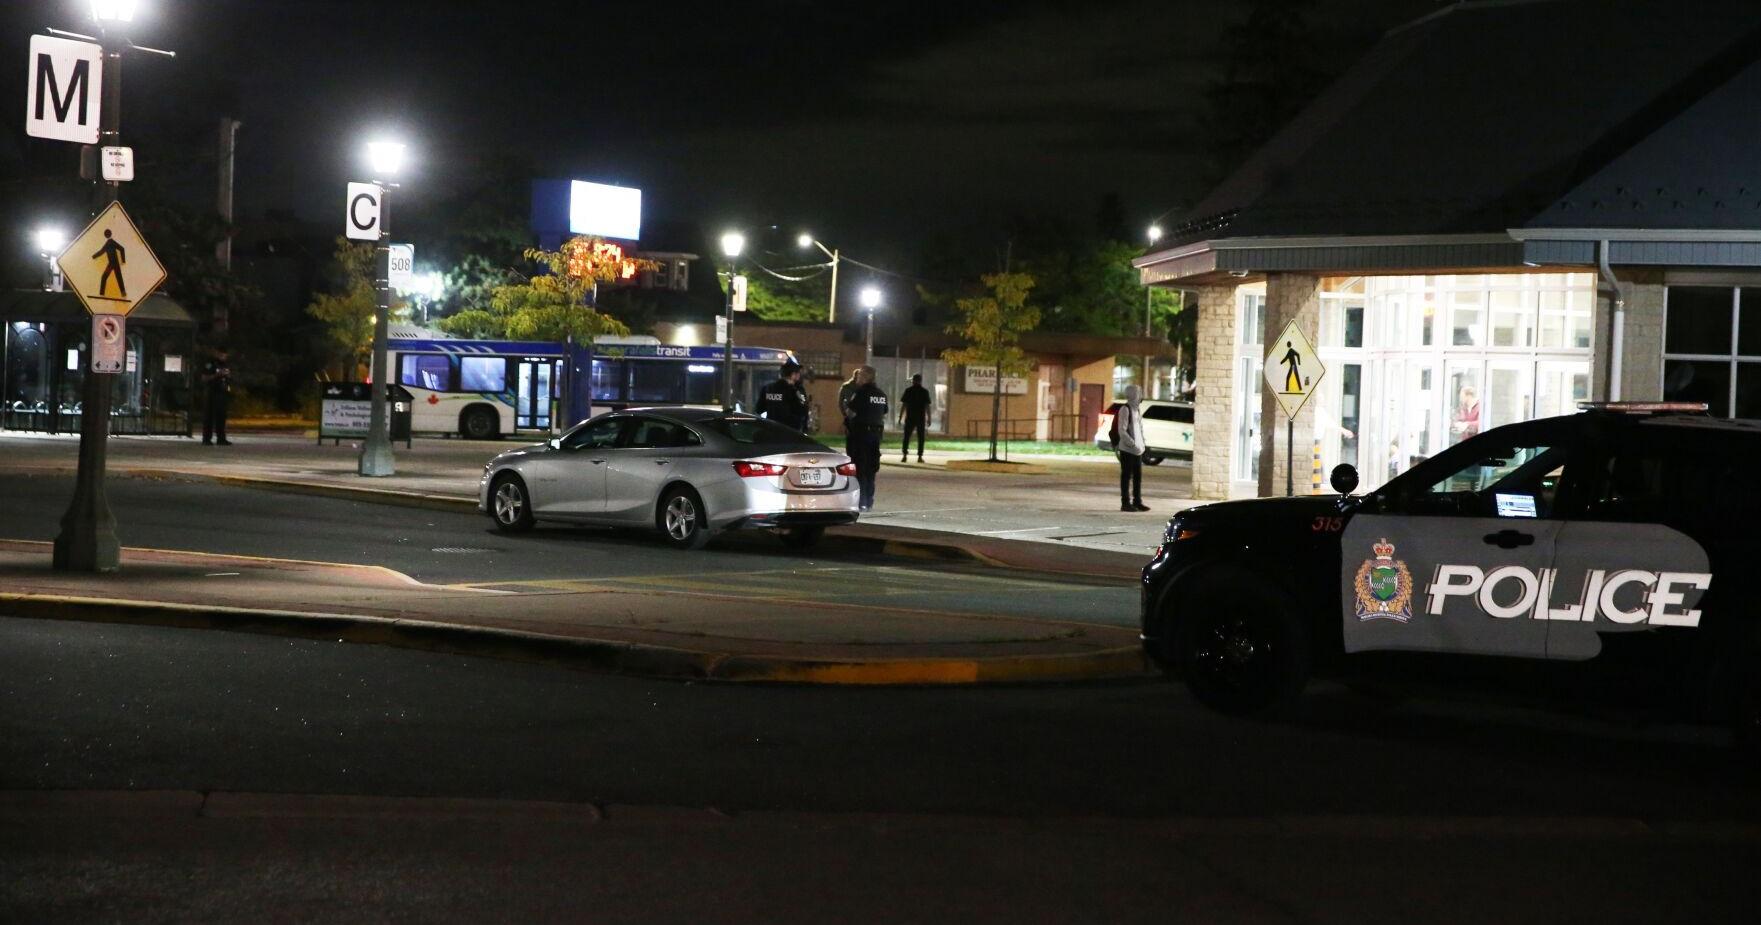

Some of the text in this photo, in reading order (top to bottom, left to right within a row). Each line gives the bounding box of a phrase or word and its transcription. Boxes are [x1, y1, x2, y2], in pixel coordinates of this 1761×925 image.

[35, 53, 90, 126] M
[351, 193, 377, 231] C
[391, 258, 411, 271] 508
[656, 345, 691, 357] transit
[765, 393, 783, 401] POLICE
[869, 396, 887, 405] POLICE
[1312, 516, 1343, 531] 315
[1425, 563, 1713, 628] POLICE
